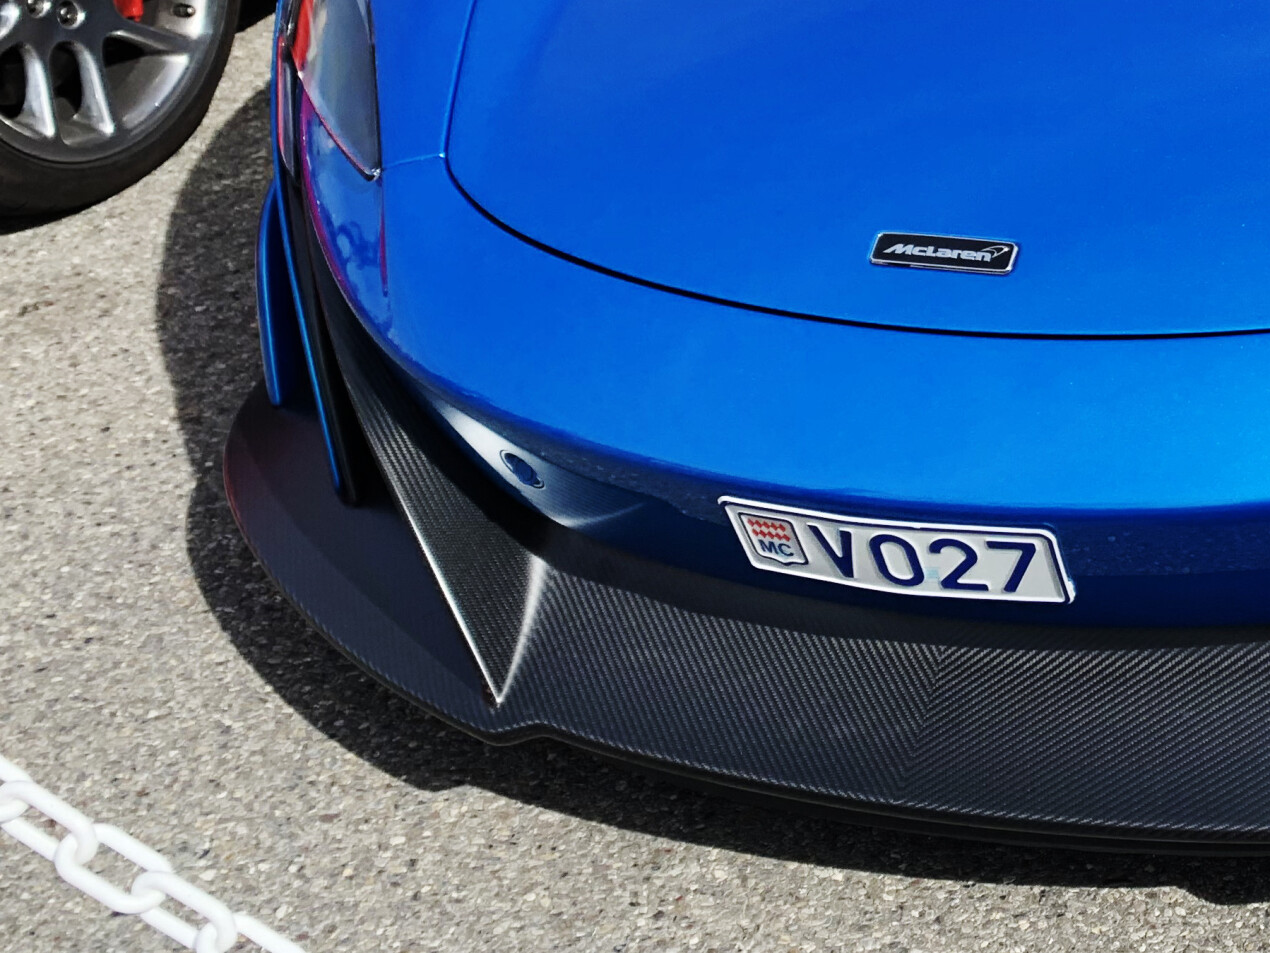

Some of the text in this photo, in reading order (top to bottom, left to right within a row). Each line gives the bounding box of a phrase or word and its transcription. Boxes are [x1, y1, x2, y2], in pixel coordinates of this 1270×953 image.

[883, 243, 992, 263] McLaren
[757, 538, 795, 557] MC
[806, 521, 1037, 594] V027
